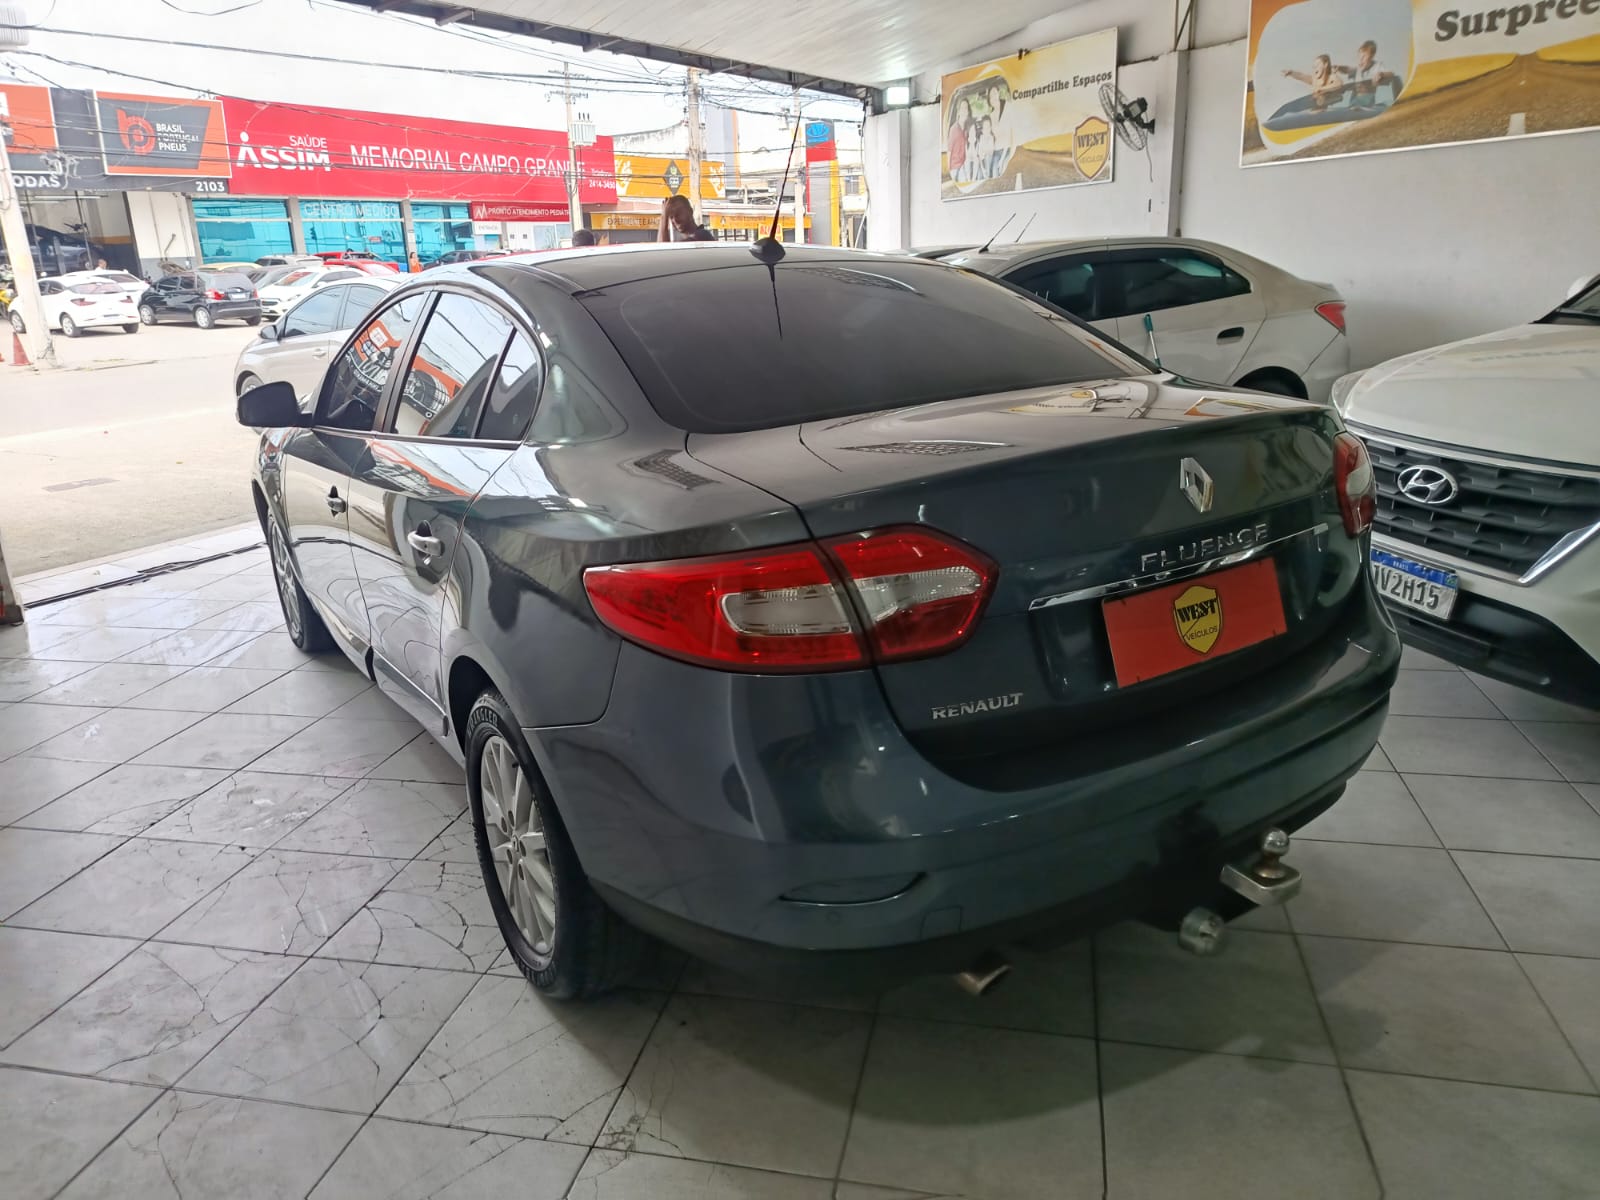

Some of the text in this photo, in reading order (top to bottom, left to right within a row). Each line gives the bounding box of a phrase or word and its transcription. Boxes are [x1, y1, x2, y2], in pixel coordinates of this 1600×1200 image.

[1012, 70, 1112, 99] Compartilhe Espaços
[156, 123, 184, 133] BRASIL
[158, 142, 187, 152] PNEUS
[289, 134, 328, 149] SAÚDE
[1077, 131, 1108, 148] WEST
[350, 144, 586, 180] MEMORIAL CAMPO GRANE
[195, 181, 225, 192] 2103
[1141, 523, 1268, 572] FLUENCE
[1176, 597, 1218, 623] WEST
[1186, 625, 1219, 642] VEÍCULOS
[931, 692, 1023, 720] RENAULT
